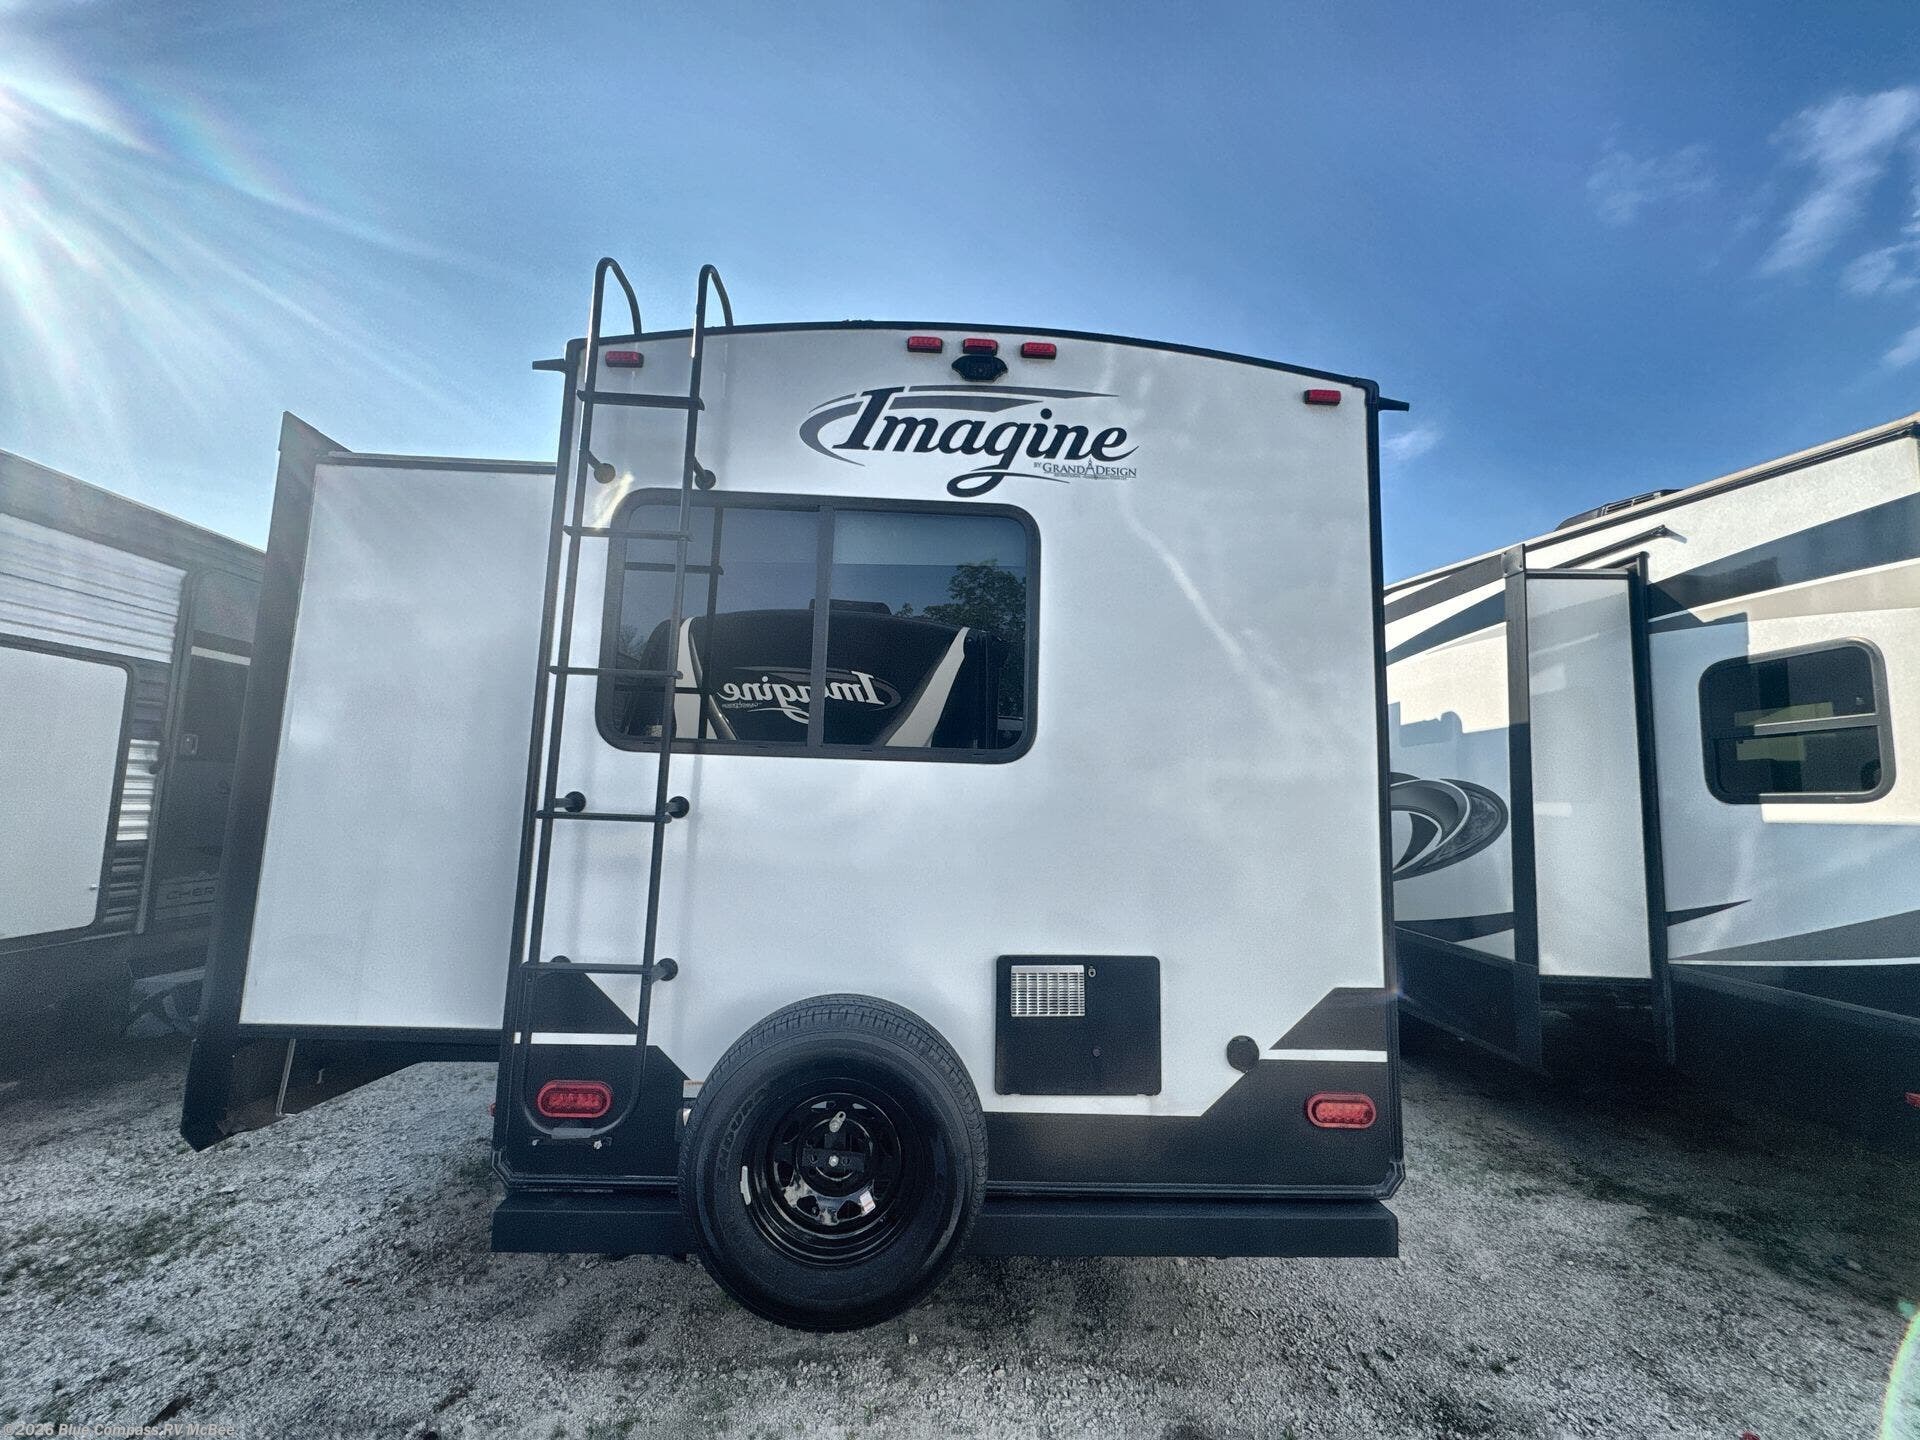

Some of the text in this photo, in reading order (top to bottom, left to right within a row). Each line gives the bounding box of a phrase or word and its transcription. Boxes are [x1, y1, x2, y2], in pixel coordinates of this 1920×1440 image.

[831, 386, 1140, 497] Imagine
[1042, 462, 1086, 474] GRAND
[1096, 465, 1137, 476] DESIGN
